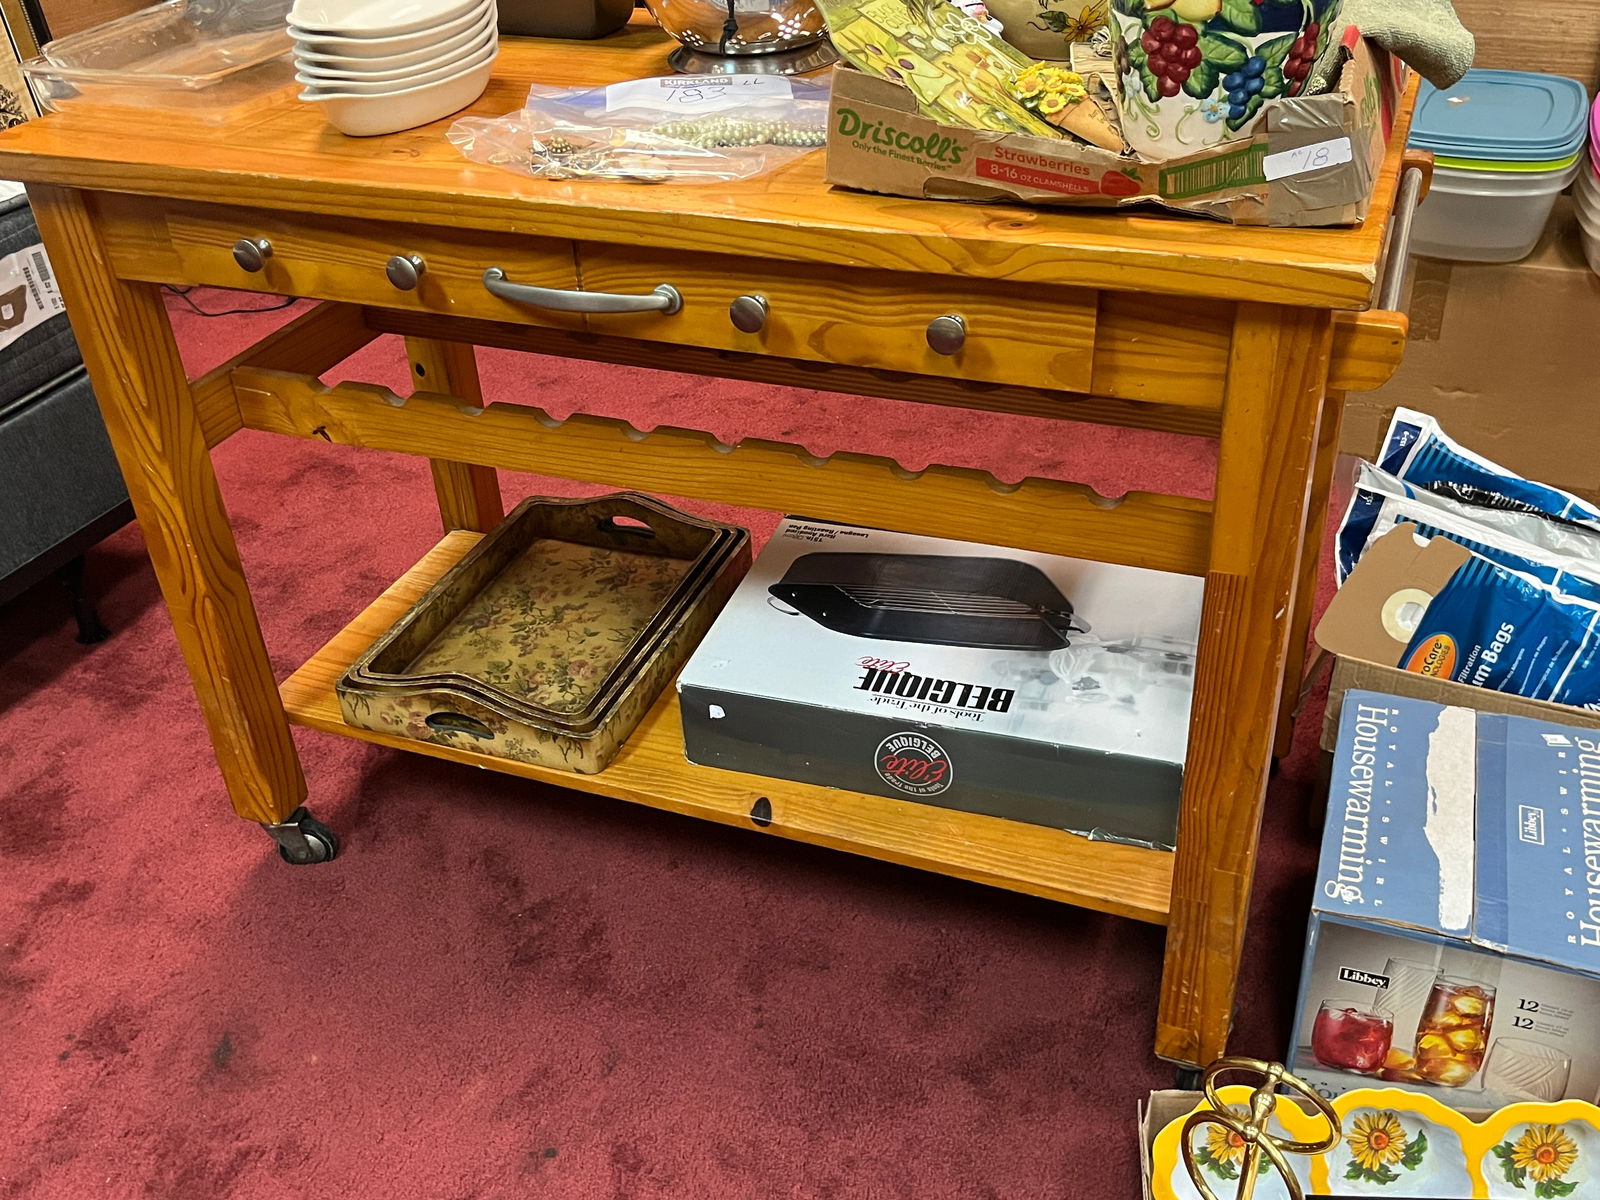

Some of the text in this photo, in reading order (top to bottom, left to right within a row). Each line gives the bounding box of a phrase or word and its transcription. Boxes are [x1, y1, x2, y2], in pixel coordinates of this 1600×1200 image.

[664, 78, 729, 86] KIRKLAND
[837, 108, 968, 164] Driscoll's
[852, 140, 873, 153] Only
[873, 145, 888, 156] the
[888, 150, 915, 163] Finest
[994, 146, 1091, 176] Strawberries
[990, 164, 1018, 179] 8-16
[1033, 176, 1090, 192] CLAMSHELLS
[1481, 621, 1515, 664] Bags
[855, 656, 910, 675] Elite
[1421, 641, 1442, 676] roCare
[1457, 644, 1482, 684] Filtration
[853, 666, 1016, 713] BELGIQUE
[870, 697, 985, 722] Tools of the Trade
[885, 736, 941, 759] BELGIQUE
[880, 754, 947, 782] Elite
[884, 772, 903, 788] Trade
[1324, 704, 1389, 905] Housewarming
[1374, 708, 1400, 907] ROYAL SWIRL
[1557, 751, 1577, 944] ROYAL SWIR
[1516, 998, 1539, 1013] 12
[1512, 1016, 1534, 1030] 12
